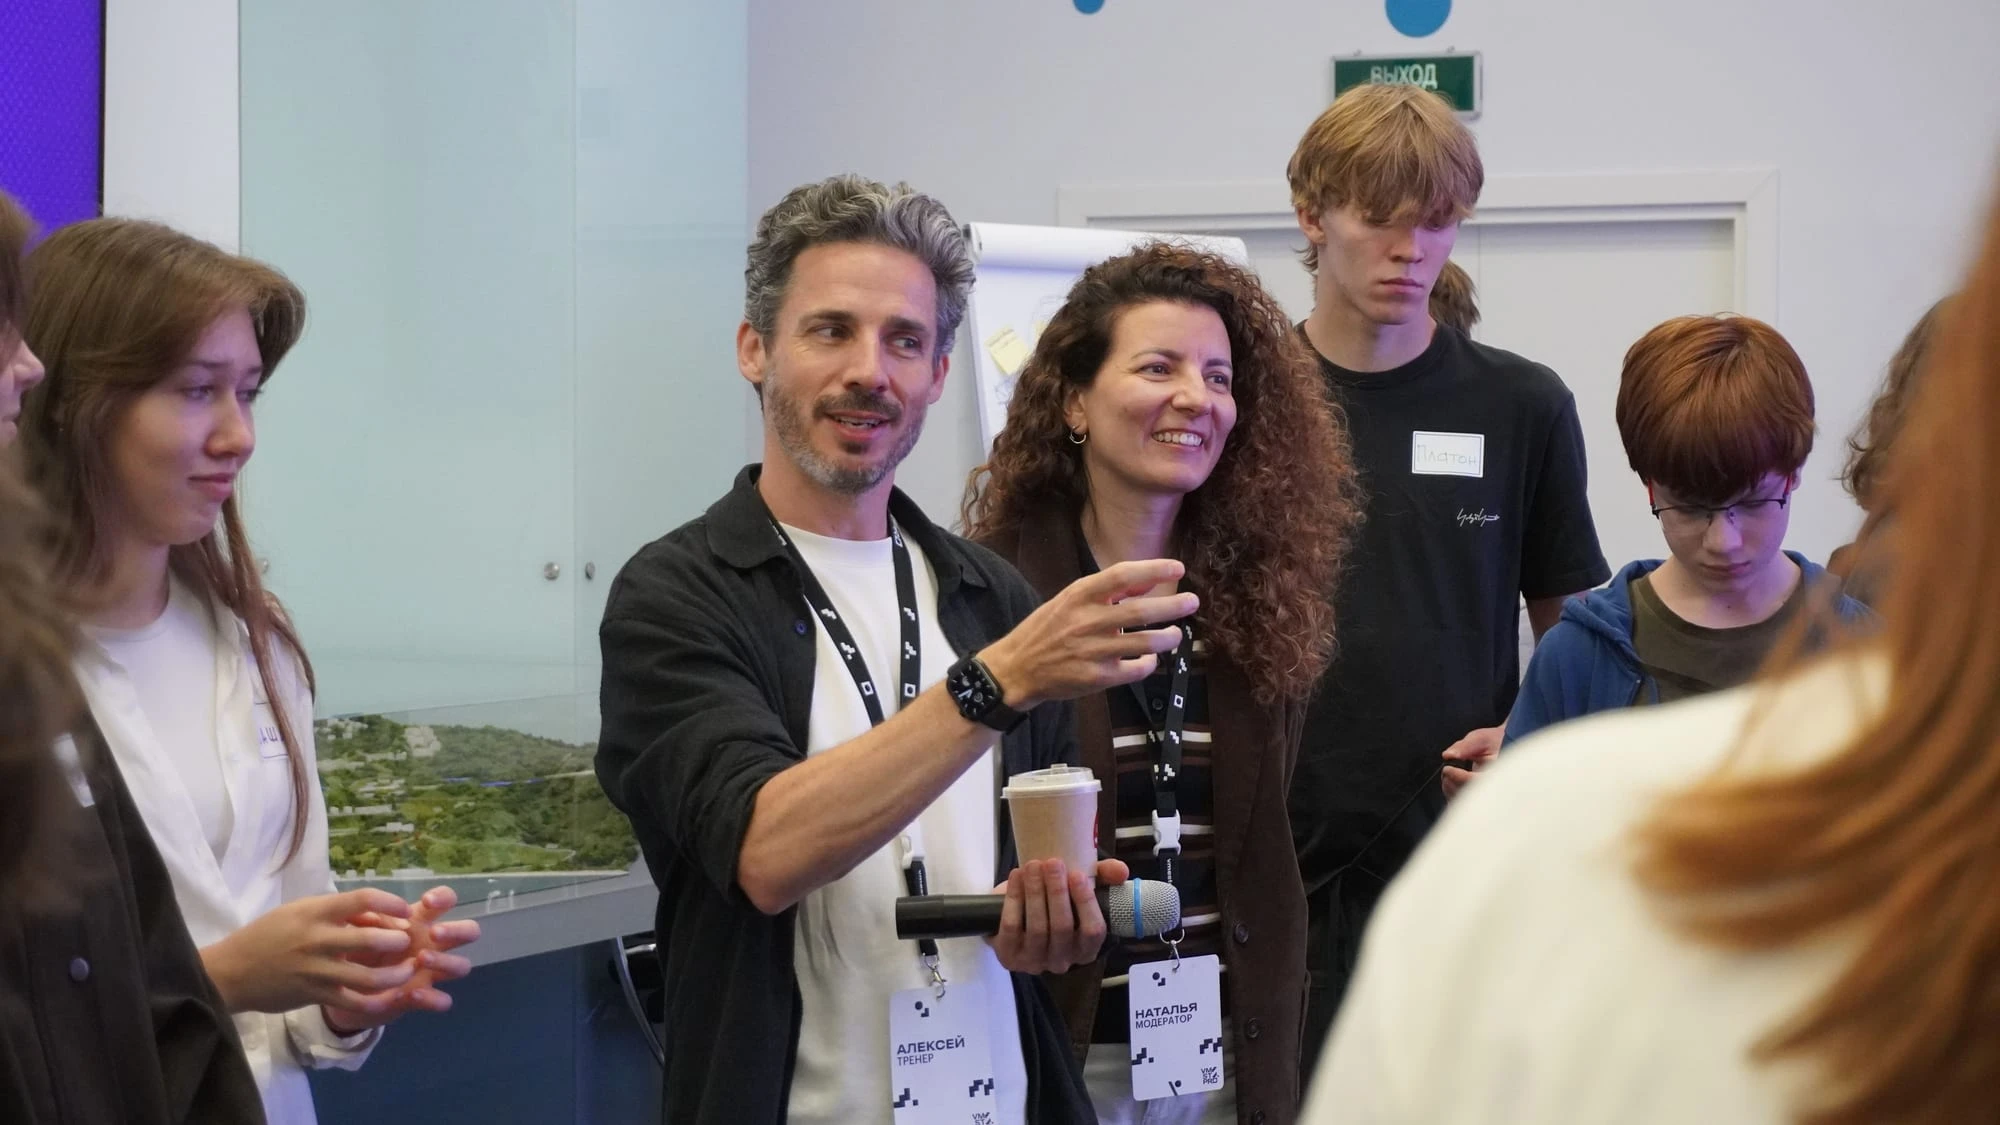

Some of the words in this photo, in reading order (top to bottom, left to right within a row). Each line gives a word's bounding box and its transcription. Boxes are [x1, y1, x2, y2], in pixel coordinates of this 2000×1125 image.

[1370, 63, 1438, 90] ВЫХОД
[1135, 1002, 1198, 1020] НАТАЛЬЯ
[1135, 1013, 1193, 1030] МОДЕРАТОР
[896, 1034, 966, 1055] АЛЕКСЕЙ
[896, 1053, 935, 1067] ТРЕНЕР
